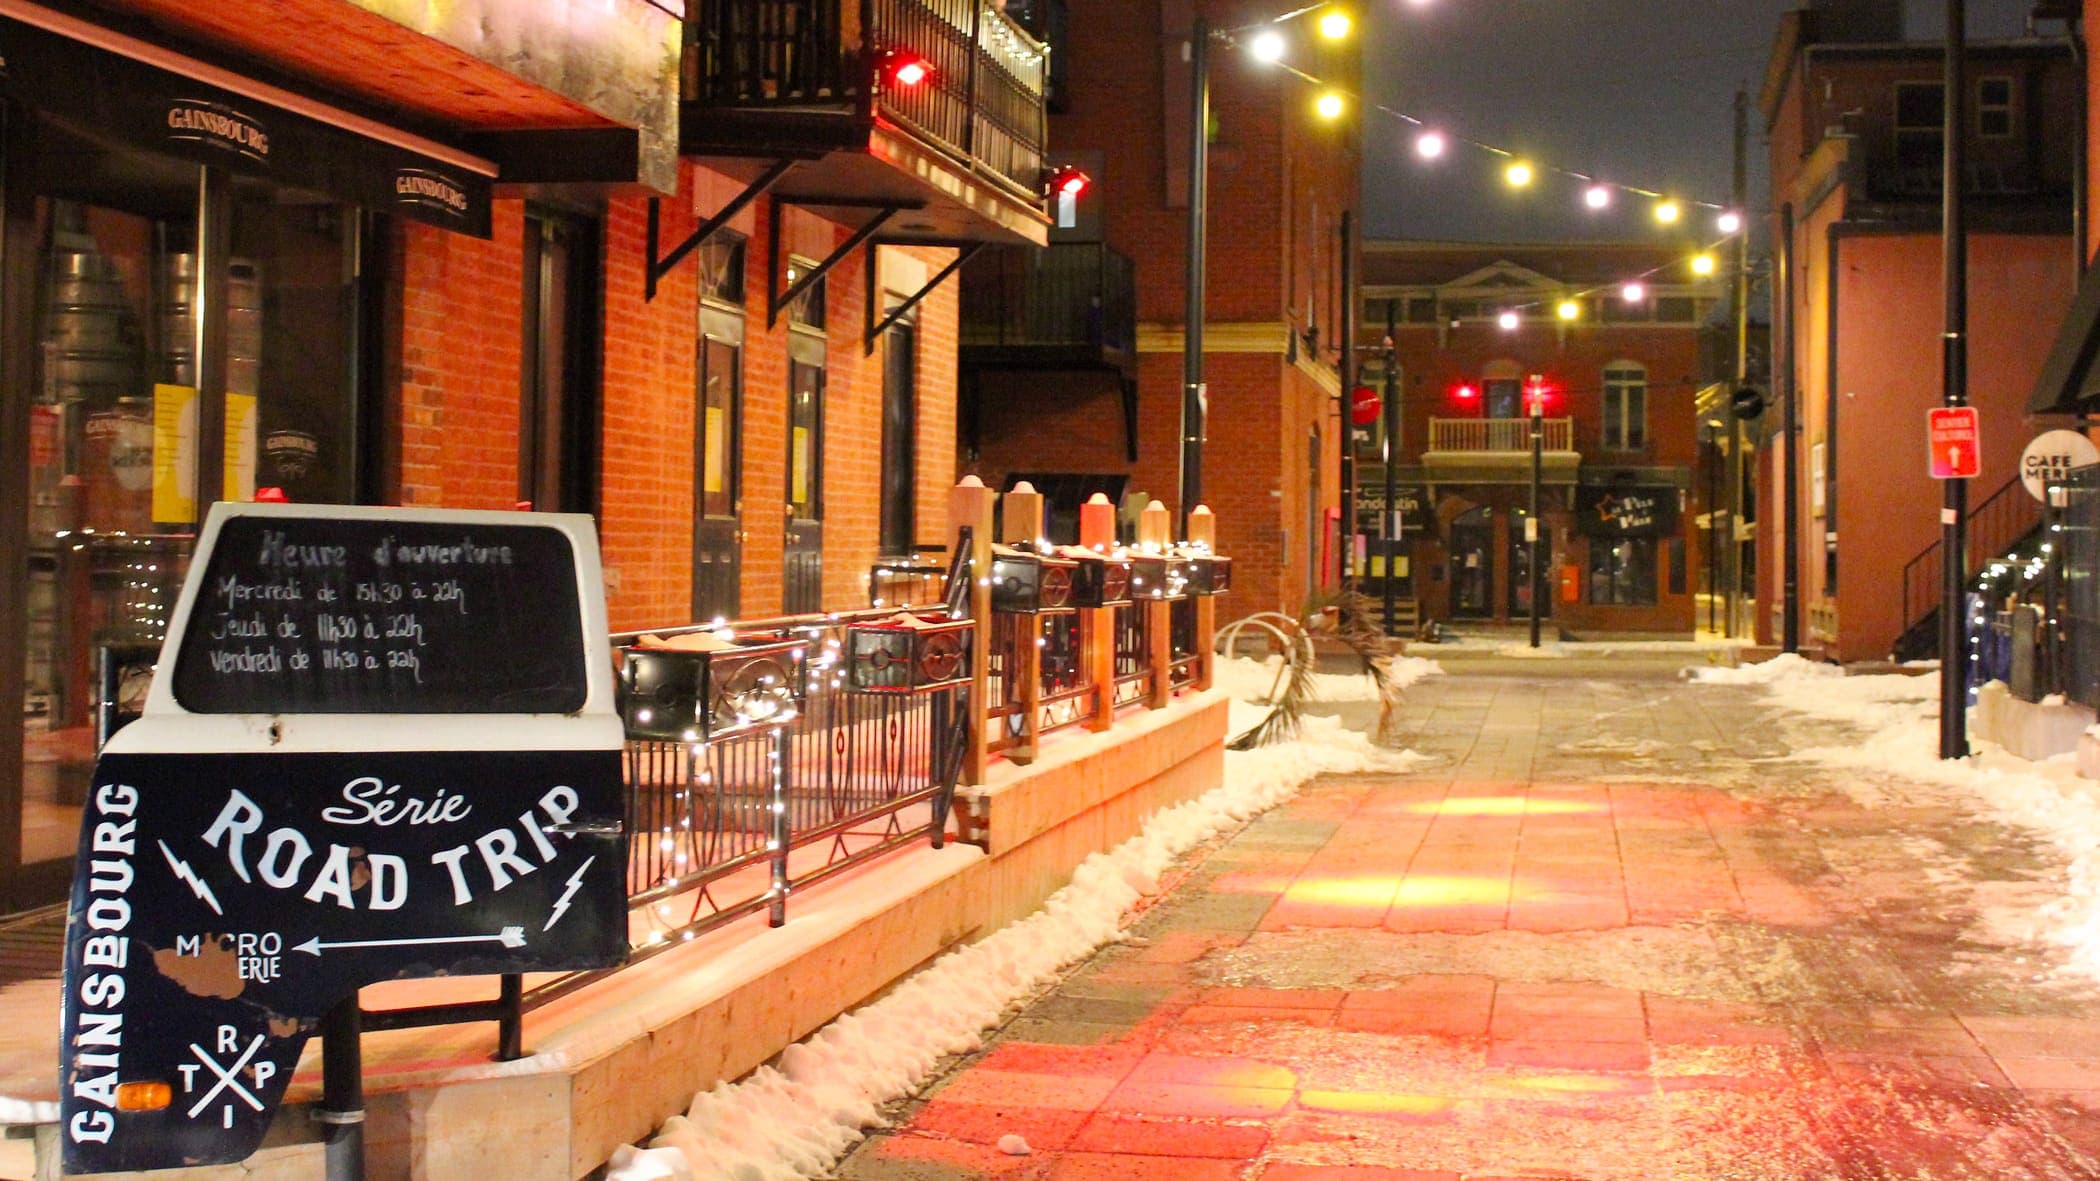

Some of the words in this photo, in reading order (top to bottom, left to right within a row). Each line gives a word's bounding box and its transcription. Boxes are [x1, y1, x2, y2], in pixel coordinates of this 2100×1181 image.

[168, 108, 269, 154] GAINSBOURG
[260, 530, 347, 567] Heure
[374, 534, 513, 567] d'ouverture
[217, 574, 303, 609] Mercredi
[317, 579, 337, 601] de
[356, 579, 402, 604] 15h30
[432, 578, 468, 615] 22h
[211, 611, 267, 640] Jeudi
[278, 613, 302, 639] de
[317, 613, 357, 643] 11h30
[363, 614, 380, 639] à
[386, 612, 427, 646] 22h
[210, 645, 282, 673] Vendredi
[290, 648, 310, 669] de
[323, 649, 358, 670] 11h30
[388, 649, 424, 683] 22h
[321, 776, 473, 826] Série
[201, 788, 408, 911] ROAD
[432, 785, 581, 906] TRIP
[70, 783, 139, 1145] GAINSBOURG
[176, 931, 283, 958] MRO
